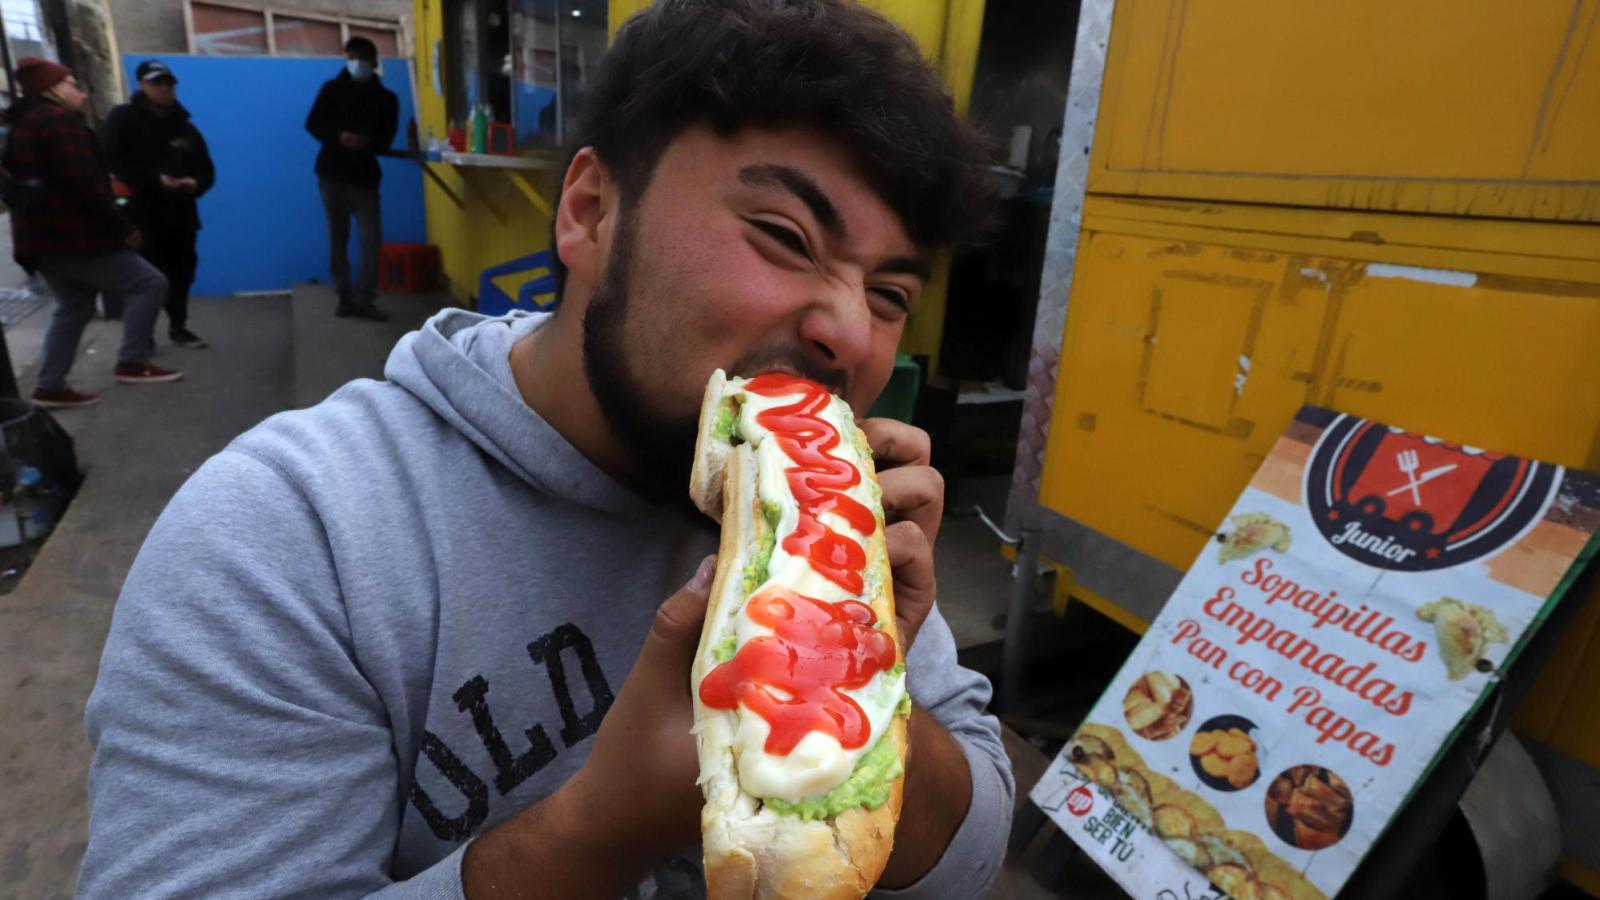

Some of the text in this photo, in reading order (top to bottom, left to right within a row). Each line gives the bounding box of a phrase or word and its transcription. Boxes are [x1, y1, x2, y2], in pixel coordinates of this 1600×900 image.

[1331, 521, 1416, 562] Junior
[1241, 558, 1427, 663] Sopaipillas
[1203, 586, 1414, 716] Empanadas
[1171, 619, 1396, 767] Pan con Papas
[1083, 816, 1113, 845] SER
[1102, 807, 1136, 839] BIEN
